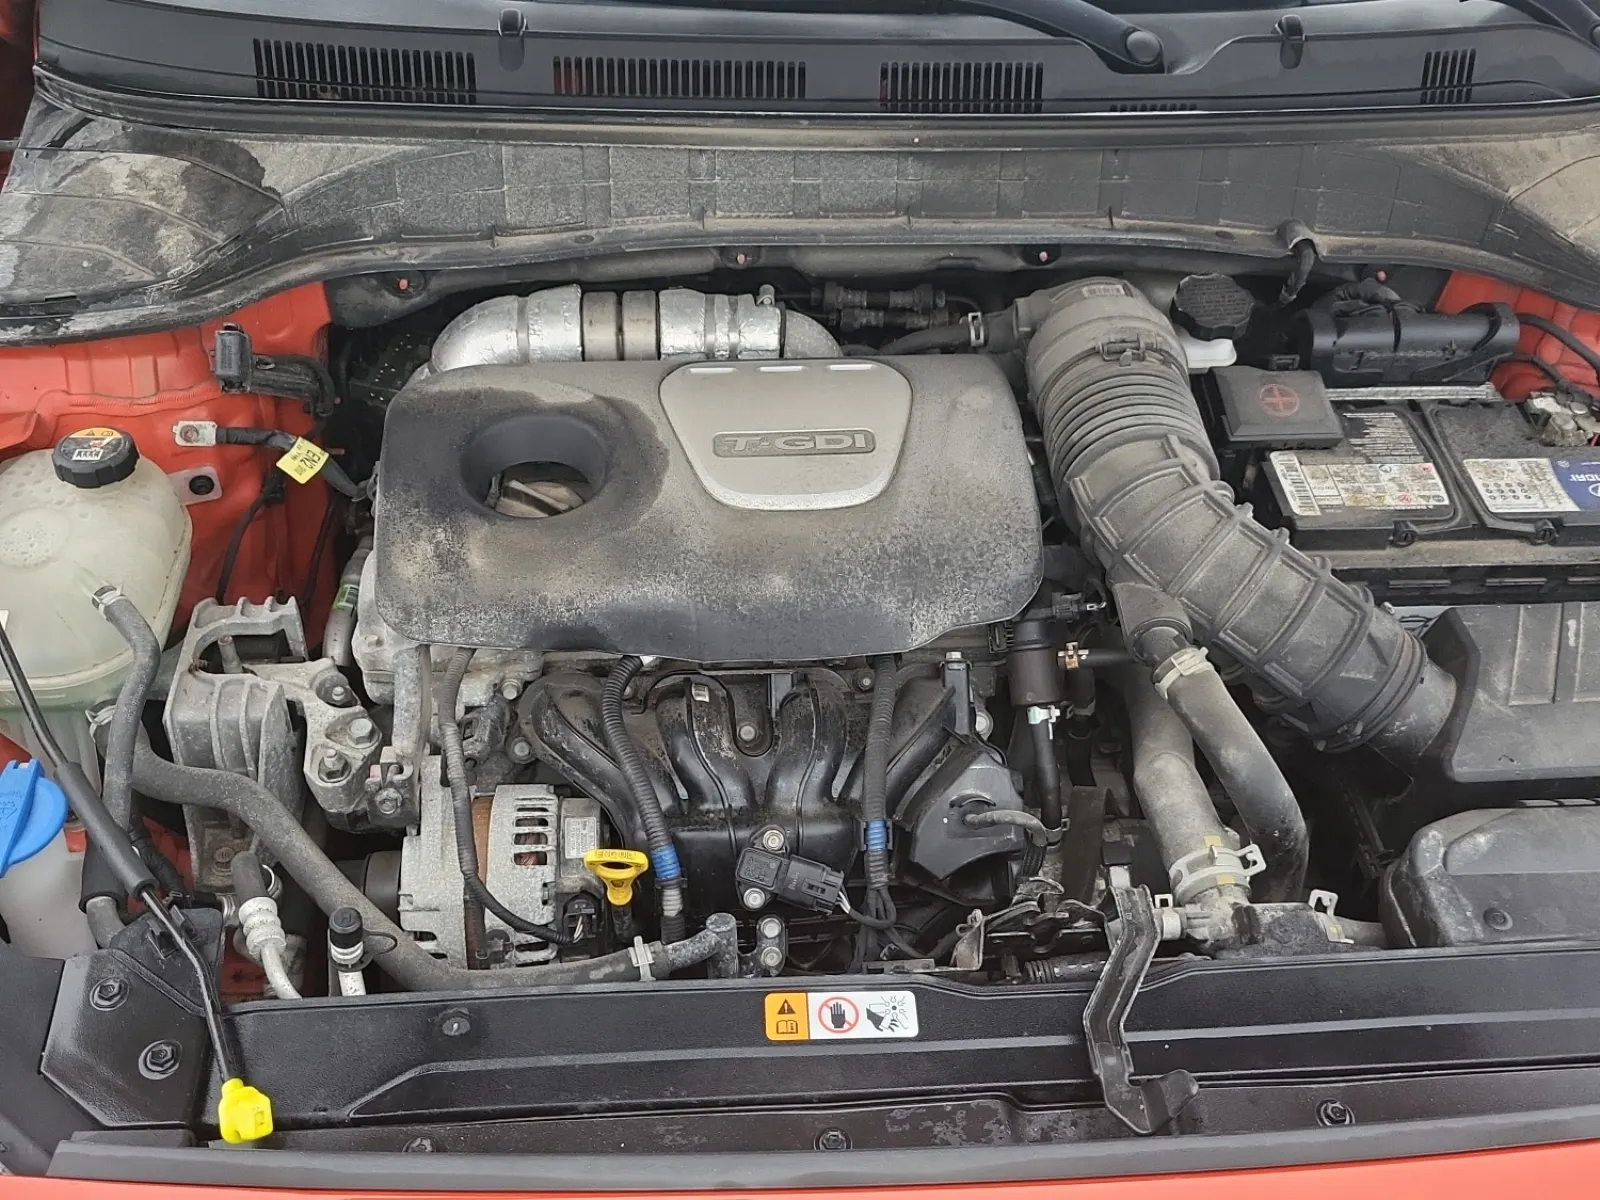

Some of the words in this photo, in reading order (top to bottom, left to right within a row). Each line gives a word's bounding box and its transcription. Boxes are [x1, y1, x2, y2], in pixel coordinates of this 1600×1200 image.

[724, 433, 866, 451] T-GDI
[299, 449, 321, 469] EN2
[596, 851, 616, 859] ENG
